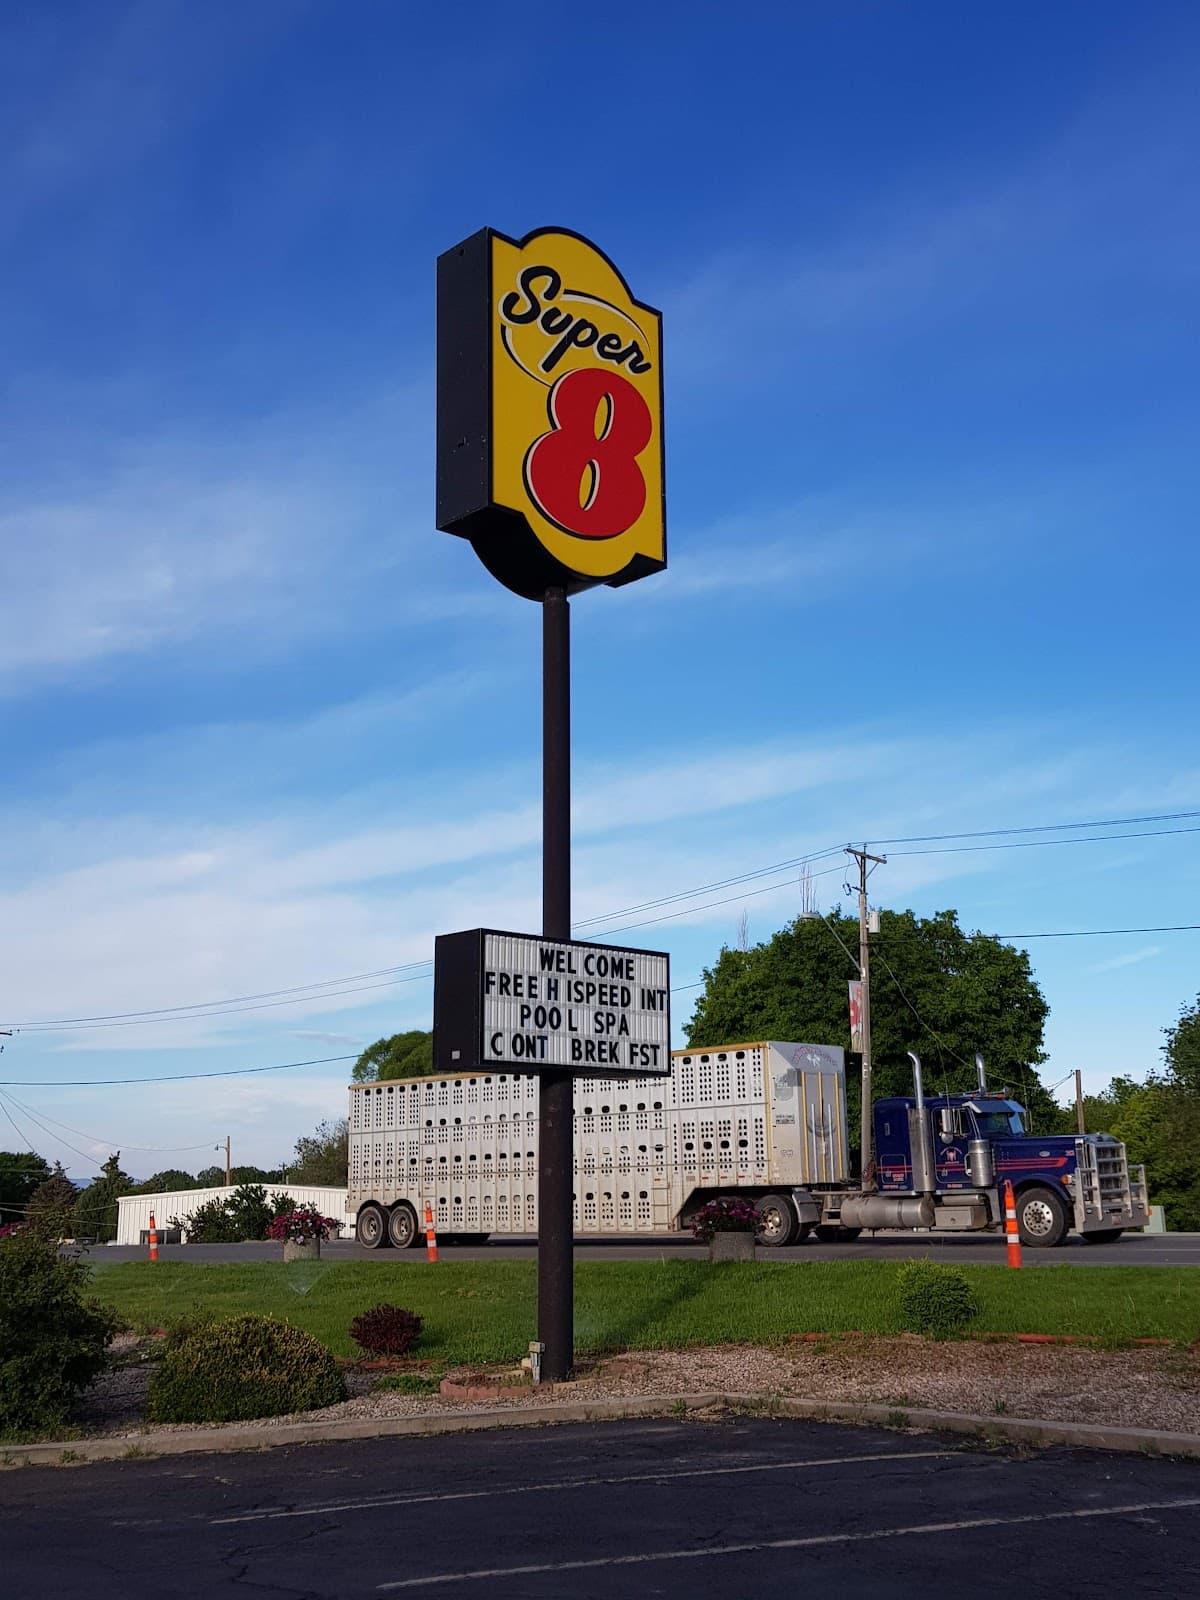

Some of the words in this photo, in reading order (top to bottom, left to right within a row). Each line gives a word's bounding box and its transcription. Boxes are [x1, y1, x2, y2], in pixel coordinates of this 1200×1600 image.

[499, 265, 652, 374] Super
[522, 367, 653, 541] 8
[539, 947, 635, 981] WELCOME
[485, 971, 538, 999] FREE
[641, 988, 667, 1012] INT
[520, 1004, 578, 1032] POOL
[594, 1011, 630, 1036] SPA
[490, 1032, 548, 1059] CONT
